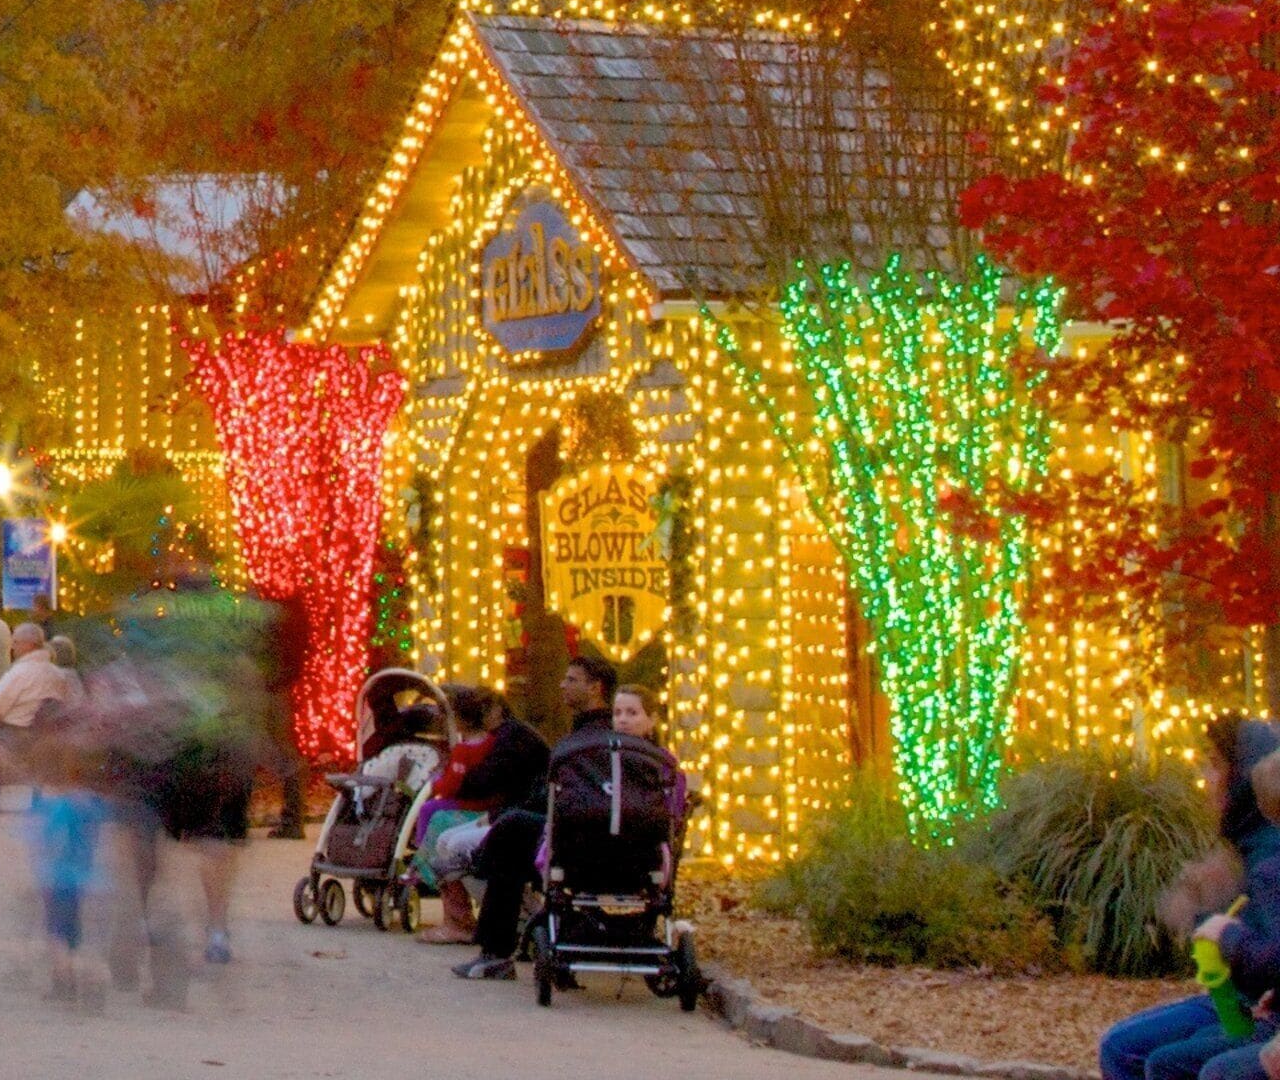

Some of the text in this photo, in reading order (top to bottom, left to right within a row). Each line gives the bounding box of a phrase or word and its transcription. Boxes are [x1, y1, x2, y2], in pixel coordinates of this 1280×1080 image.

[558, 475, 661, 526] GLAS
[554, 531, 663, 563] BLOWIN
[570, 567, 665, 601] INSIDE
